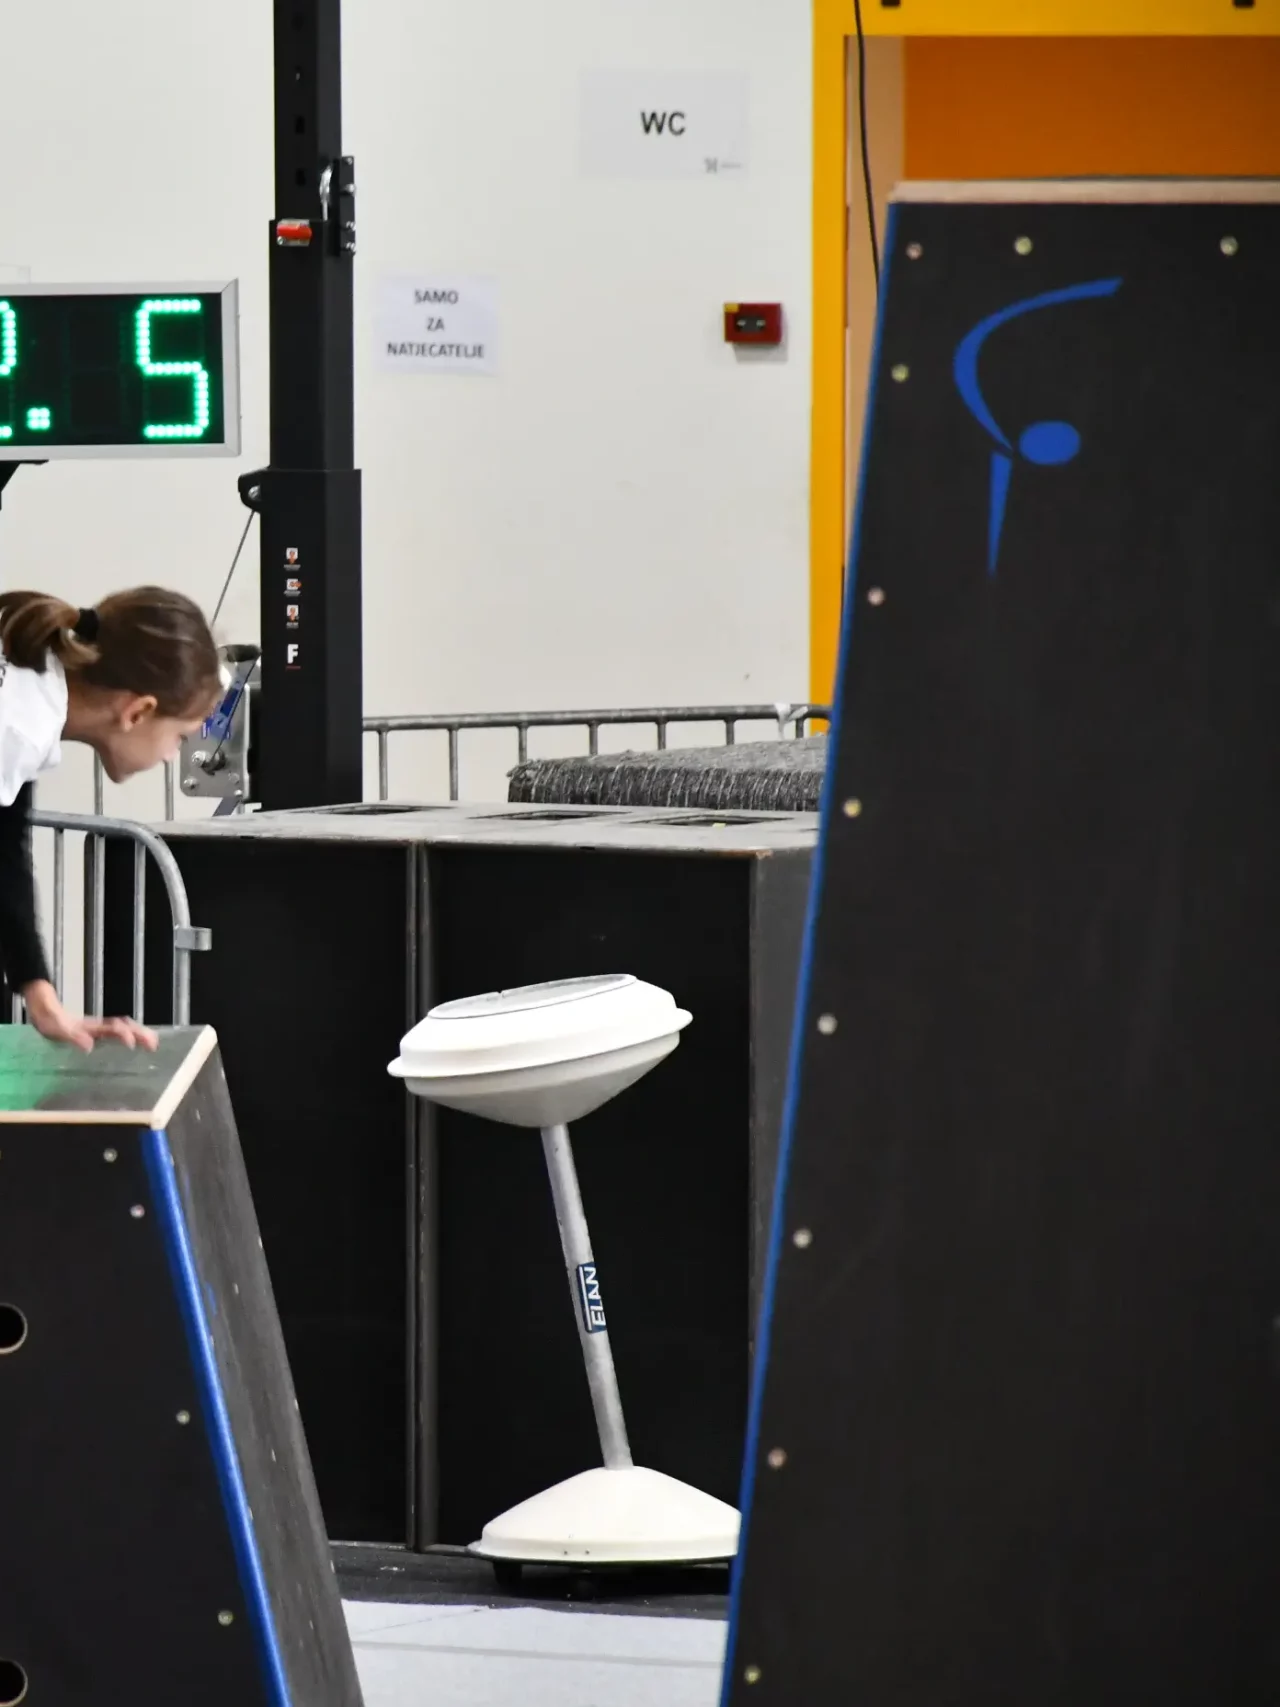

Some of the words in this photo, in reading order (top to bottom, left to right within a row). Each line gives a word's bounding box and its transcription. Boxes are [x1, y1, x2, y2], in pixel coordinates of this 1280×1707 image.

[640, 110, 686, 137] WC
[414, 289, 460, 304] SAMO
[426, 316, 446, 332] ZA
[387, 341, 486, 359] NATJECATELJE
[583, 1265, 607, 1327] ELAN
